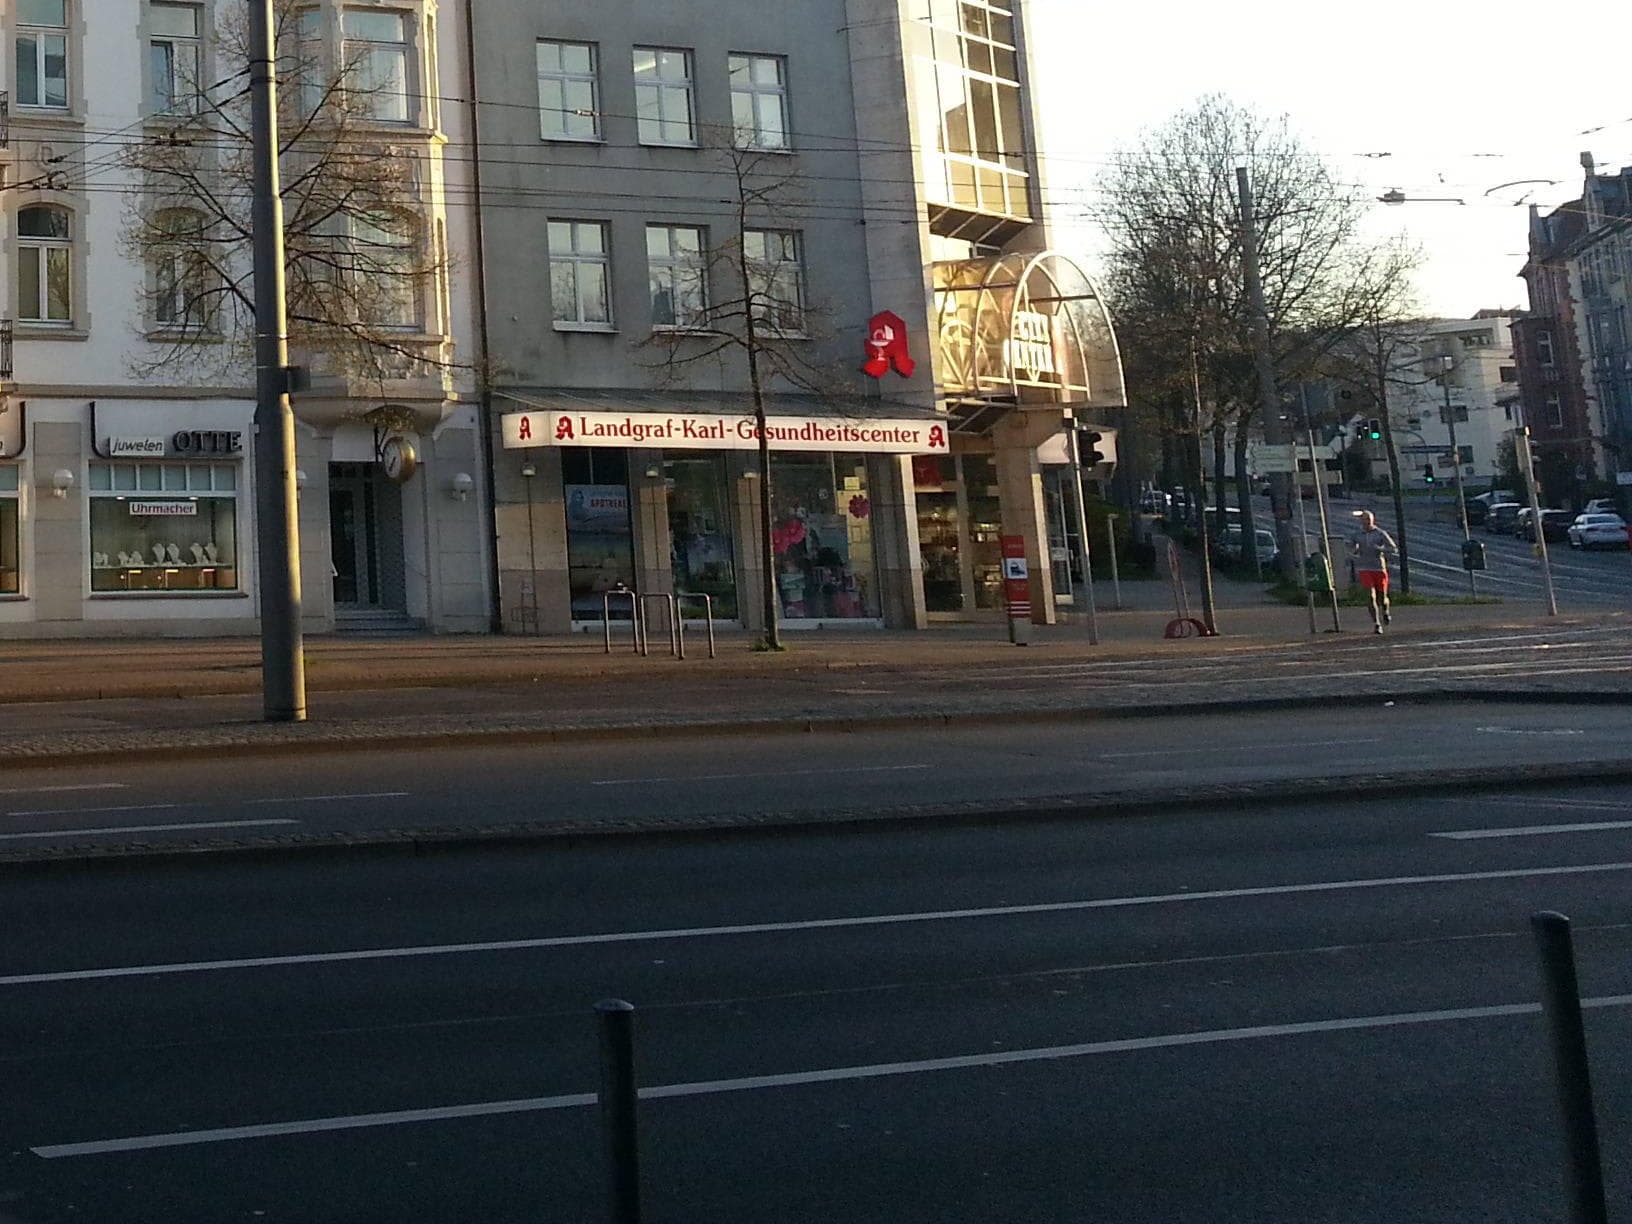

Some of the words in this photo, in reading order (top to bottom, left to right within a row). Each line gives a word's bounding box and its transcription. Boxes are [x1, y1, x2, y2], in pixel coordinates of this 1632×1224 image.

[112, 439, 163, 453] juwelen
[172, 430, 243, 452] OTTE
[131, 504, 194, 514] Uhrmacher
